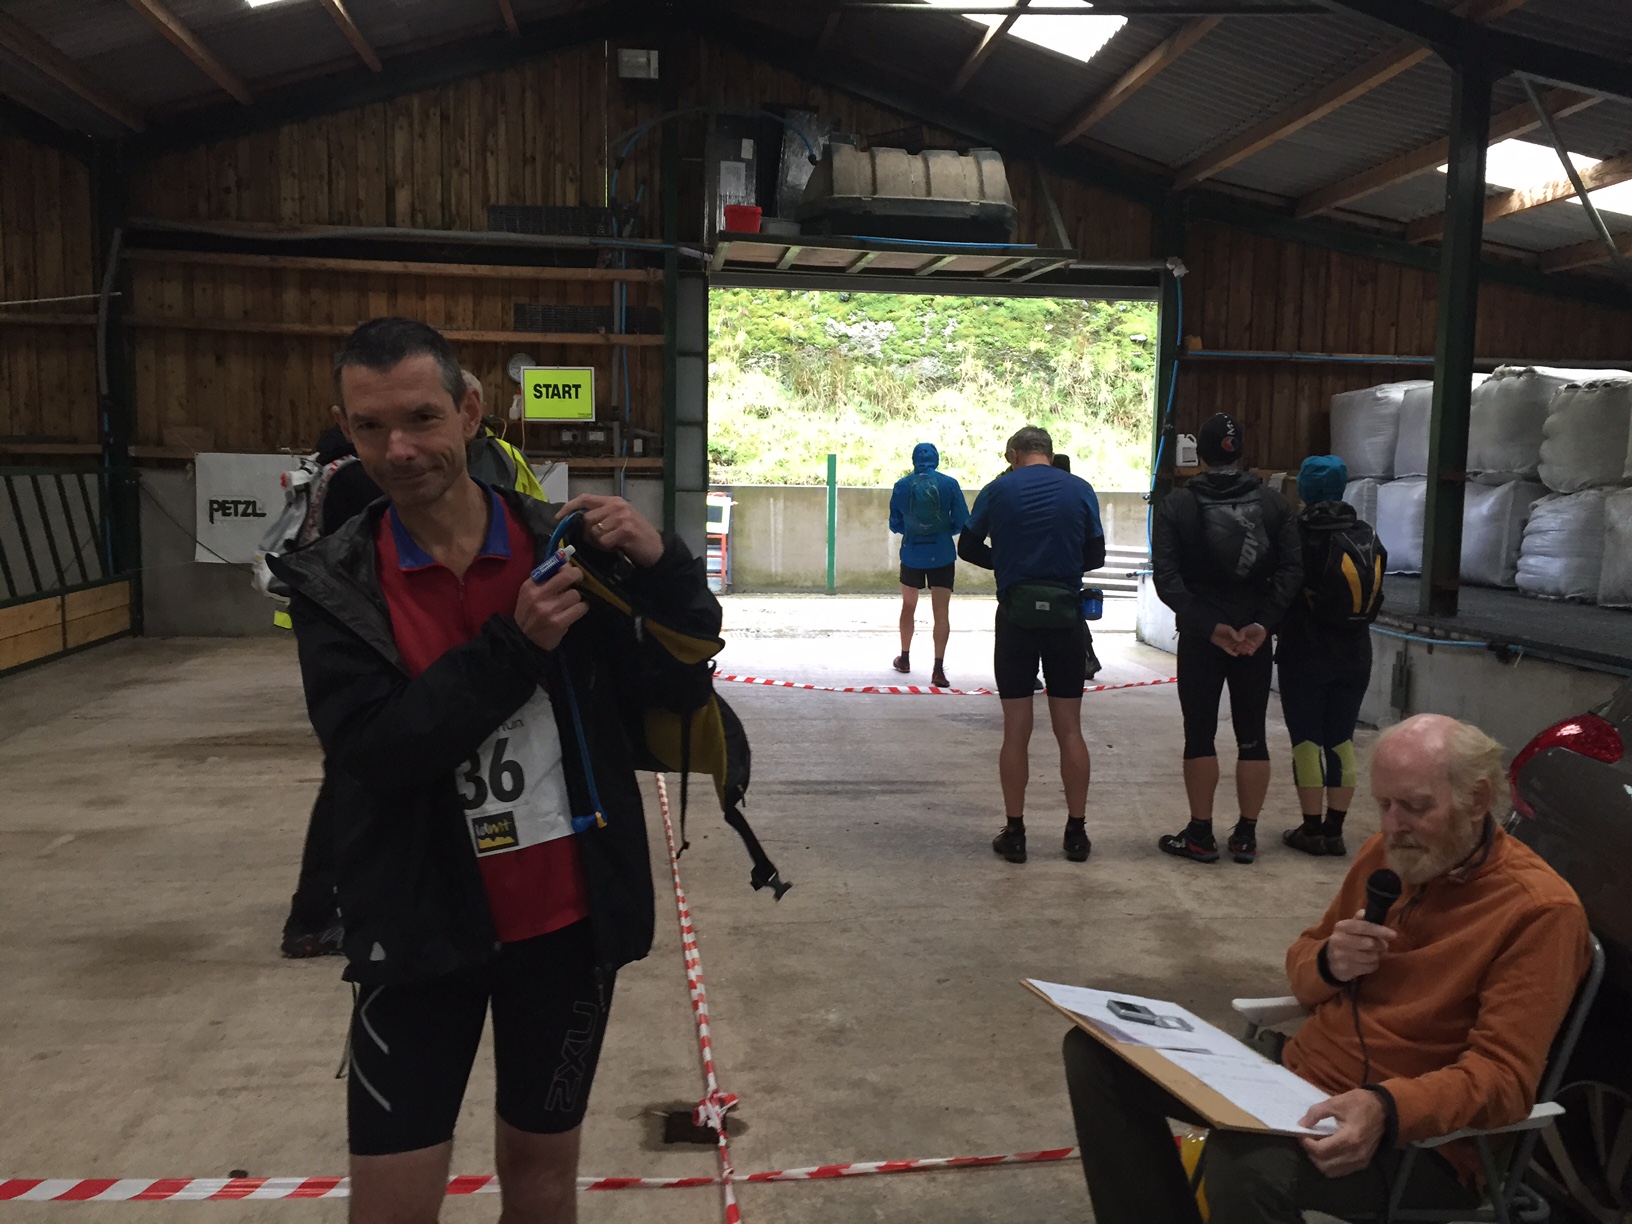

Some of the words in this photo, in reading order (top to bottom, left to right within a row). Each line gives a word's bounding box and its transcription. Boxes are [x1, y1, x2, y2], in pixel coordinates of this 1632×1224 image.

[533, 383, 582, 399] START
[209, 499, 267, 525] PETZL
[456, 737, 525, 811] 36
[543, 1000, 599, 1112] 2XU
